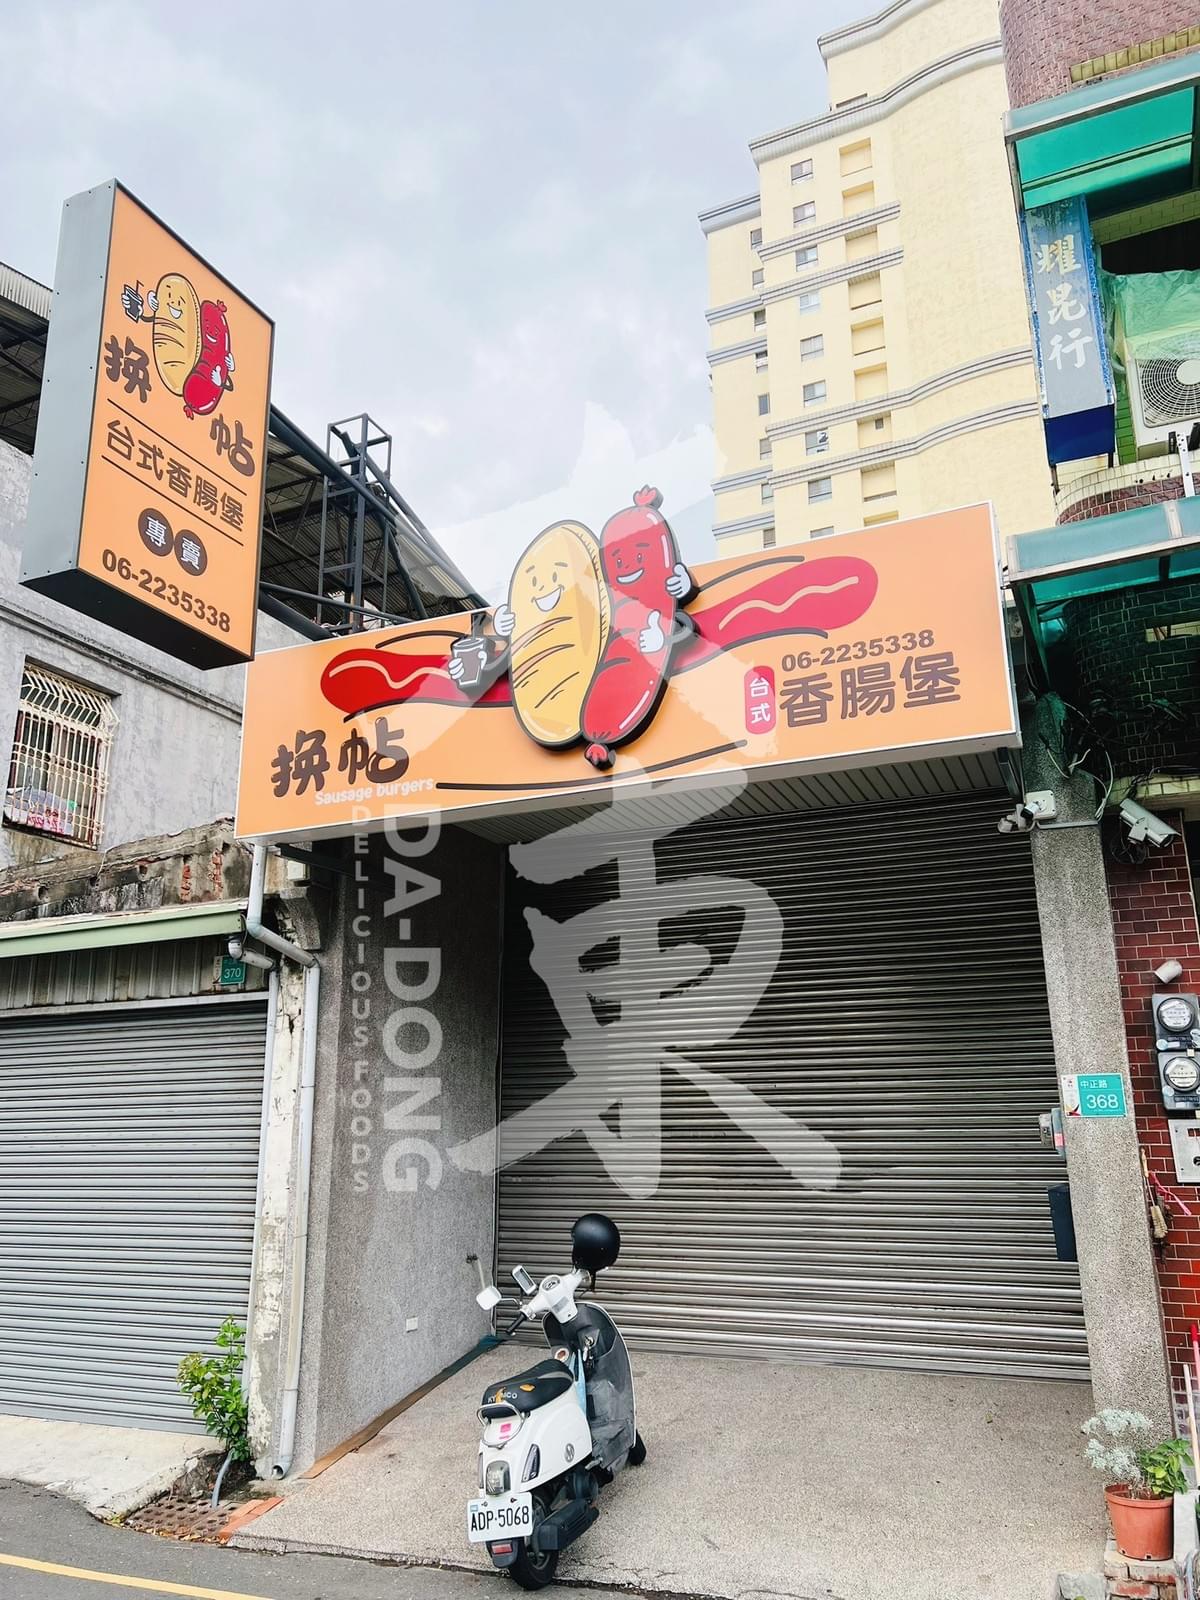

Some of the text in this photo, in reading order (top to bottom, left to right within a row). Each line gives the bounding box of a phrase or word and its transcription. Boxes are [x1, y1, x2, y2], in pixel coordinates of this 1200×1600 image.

[106, 420, 244, 532] 台式香腸堡
[102, 548, 231, 633] 06-2235338
[781, 629, 934, 672] 06-2235338
[750, 676, 771, 724] 台式
[779, 651, 961, 728] 香腸堡
[315, 778, 434, 805] Sausage burgers
[223, 967, 241, 979] 370
[1080, 1079, 1108, 1089] 中正路
[1086, 1093, 1119, 1109] 368
[470, 1505, 530, 1532] ADP-5068
